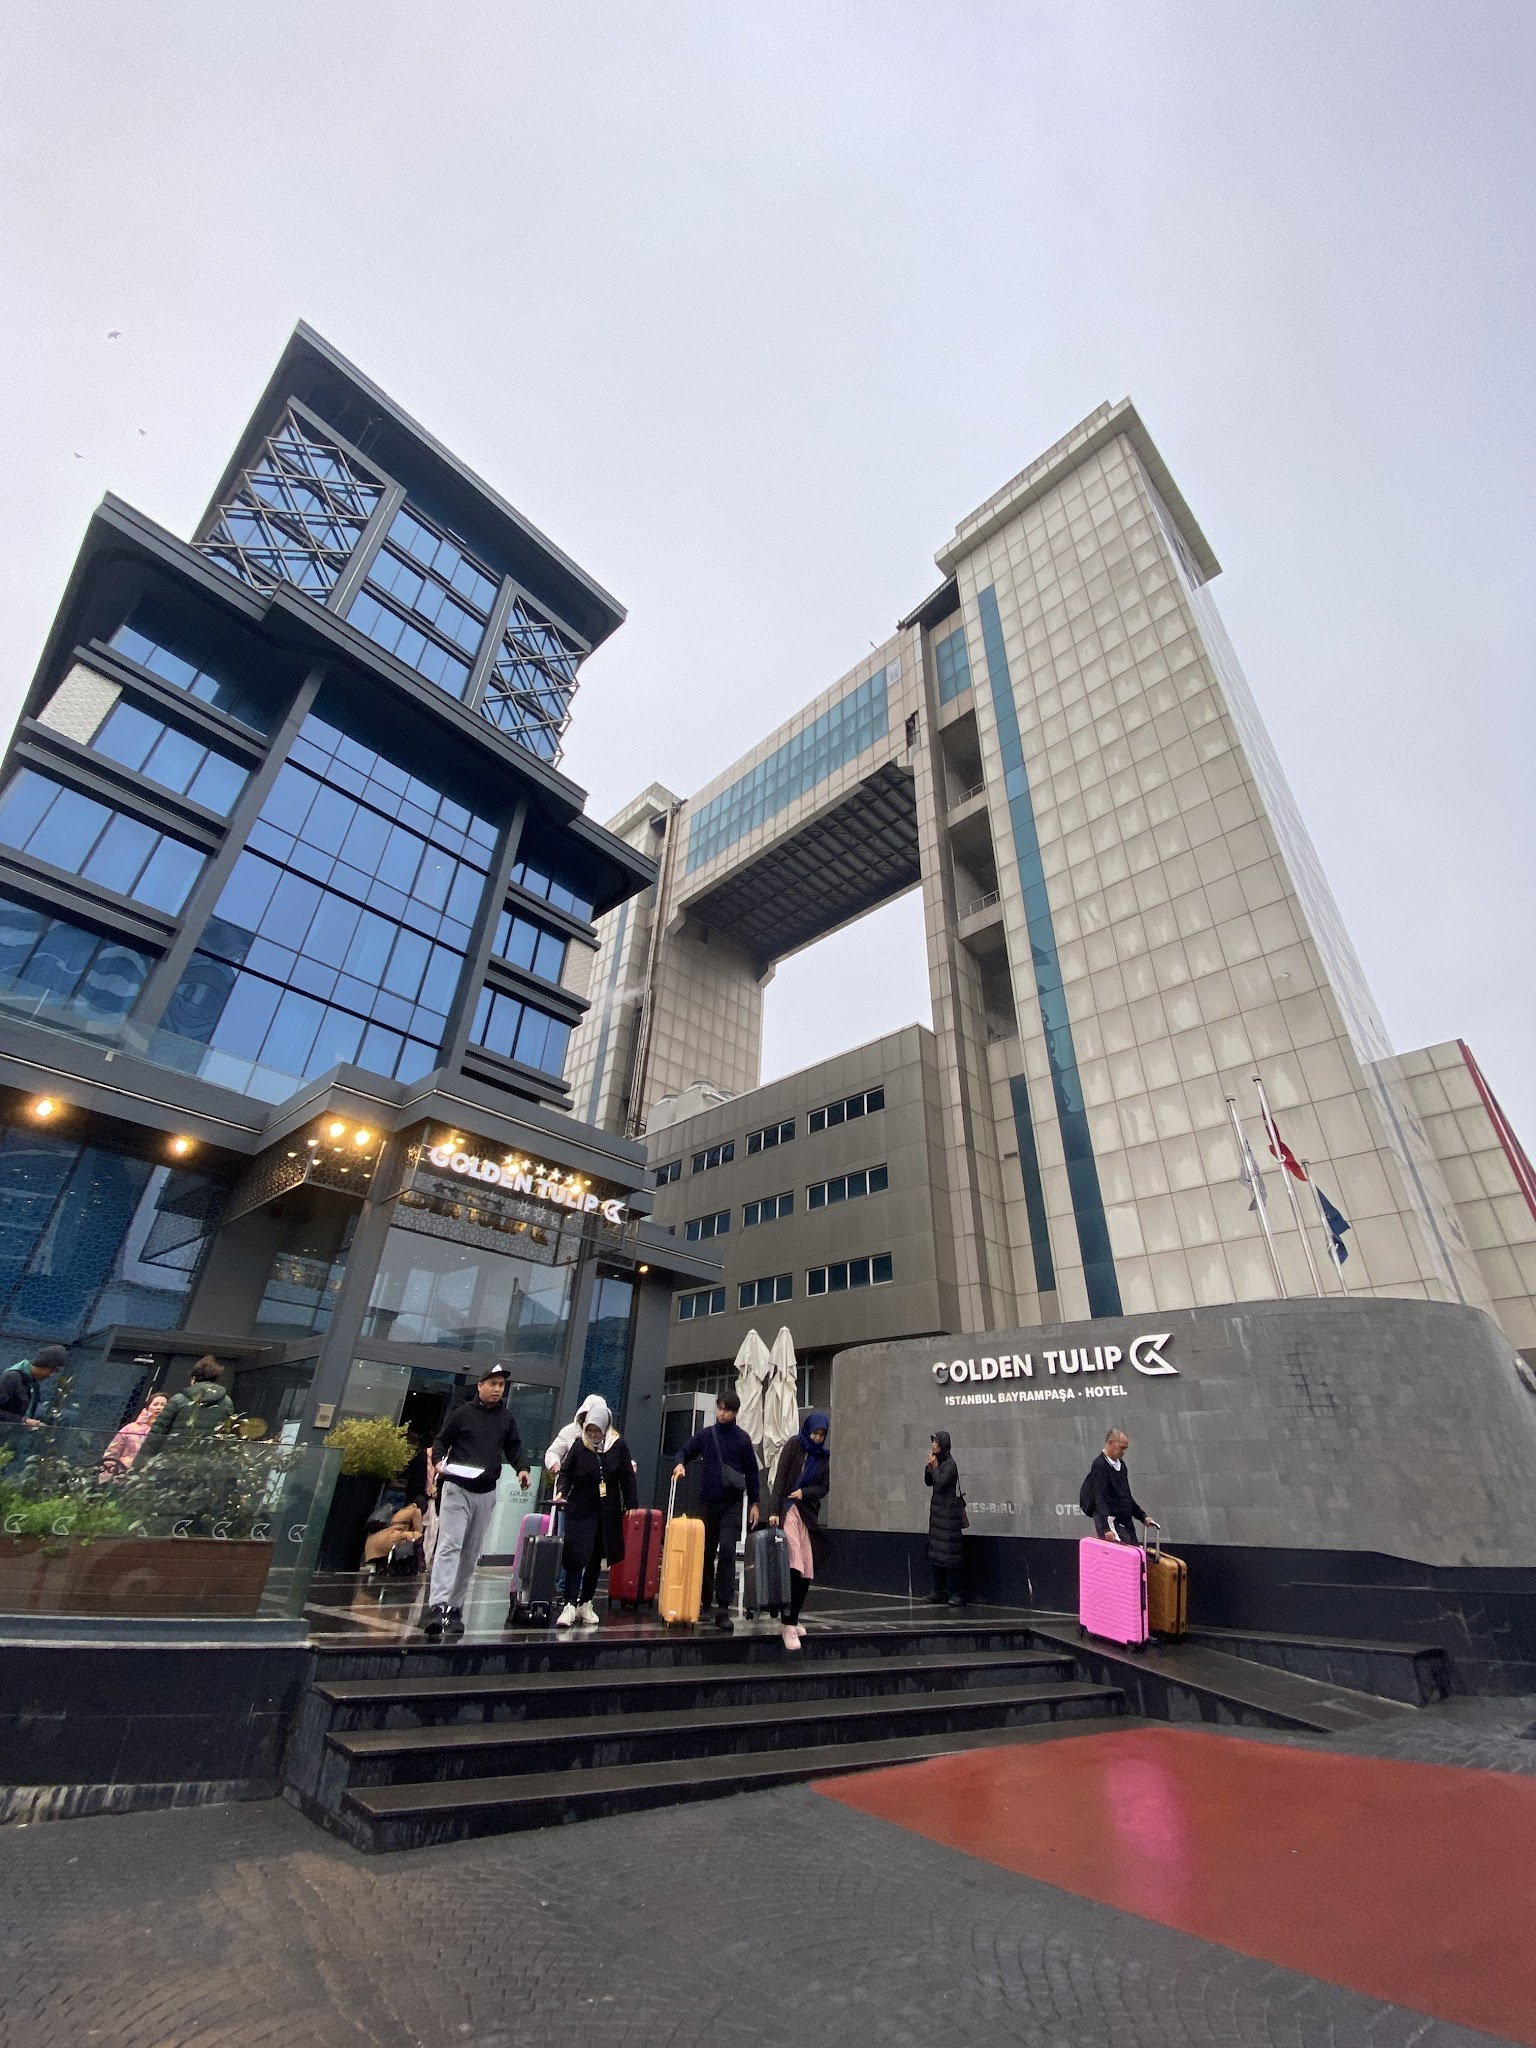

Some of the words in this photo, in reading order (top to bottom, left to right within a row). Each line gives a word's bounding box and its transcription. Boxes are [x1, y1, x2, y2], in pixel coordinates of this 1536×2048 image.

[430, 1146, 533, 1194] GOLDEN
[536, 1178, 599, 1212] TULIP
[932, 1354, 1033, 1384] GOLDEN
[1043, 1346, 1122, 1375] TULIP
[998, 1388, 1075, 1403] BAYRAMPAŞA
[1085, 1385, 1128, 1398] HOTEL
